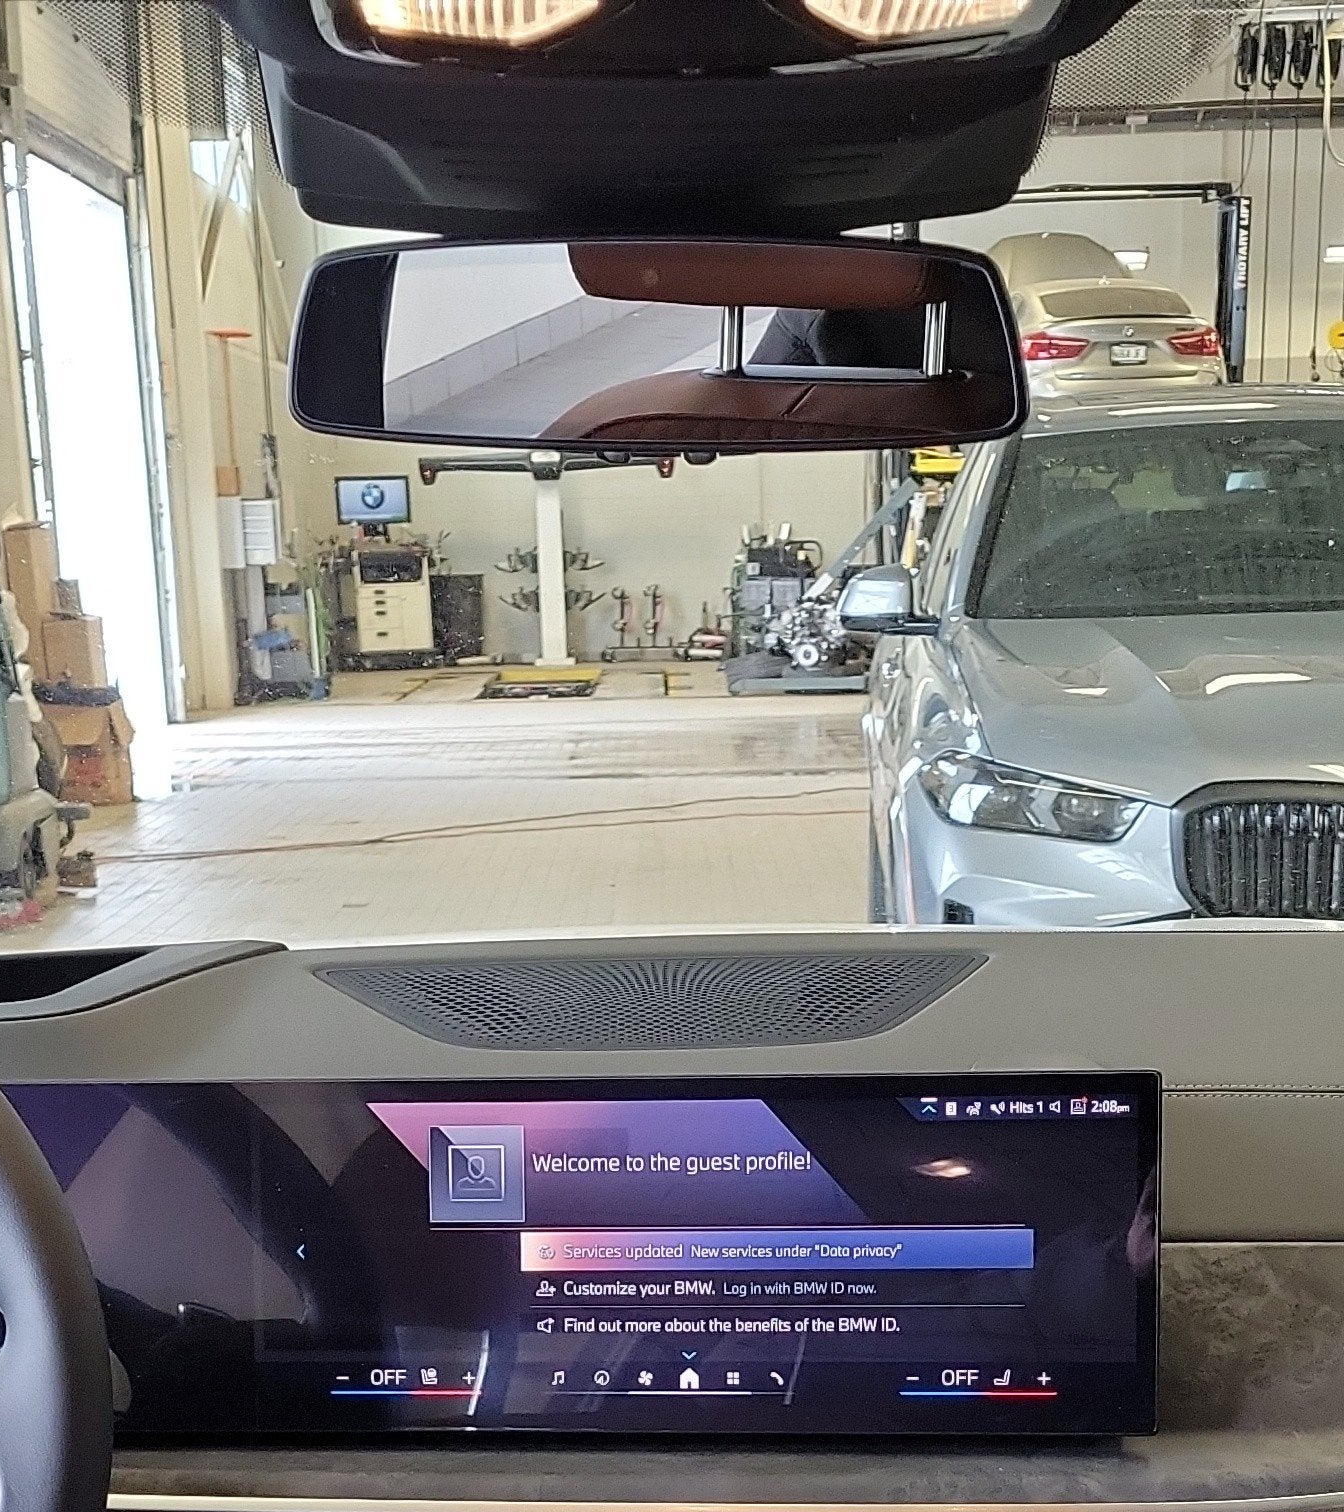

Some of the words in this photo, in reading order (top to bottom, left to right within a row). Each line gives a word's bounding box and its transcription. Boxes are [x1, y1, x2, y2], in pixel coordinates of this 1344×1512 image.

[1239, 198, 1251, 226] LIFT
[1237, 227, 1249, 280] ROTARY
[1009, 1101, 1033, 1114] Hits
[1036, 1101, 1043, 1113] 1
[1091, 1099, 1130, 1114] 2:08pm
[532, 1152, 620, 1172] Welcome
[625, 1155, 644, 1171] to
[650, 1152, 681, 1171] the
[686, 1155, 741, 1175] guest
[745, 1151, 811, 1175] profile!
[563, 1244, 622, 1259] Services
[624, 1244, 683, 1262] updated
[690, 1245, 719, 1258] New
[721, 1244, 772, 1258] services
[775, 1244, 811, 1258] under
[814, 1243, 850, 1258] "Data
[853, 1243, 903, 1260] privacy"
[563, 1280, 636, 1296] Customize
[639, 1284, 671, 1299] your
[674, 1280, 716, 1296] BMW.
[723, 1281, 747, 1298] Log
[750, 1281, 760, 1295] in
[762, 1281, 791, 1295] with
[794, 1281, 828, 1295] BMW
[830, 1281, 845, 1295] ID
[847, 1284, 877, 1295] now.
[564, 1318, 595, 1333] Find
[598, 1319, 622, 1333] out
[624, 1321, 661, 1333] more
[664, 1318, 706, 1333] about
[708, 1318, 733, 1333] the
[735, 1317, 792, 1333] benefits
[794, 1317, 809, 1333] of
[811, 1317, 835, 1333] the
[838, 1317, 877, 1333] BMW
[880, 1317, 901, 1333] ID.
[370, 1369, 407, 1386] OFF
[941, 1369, 980, 1386] OFF
